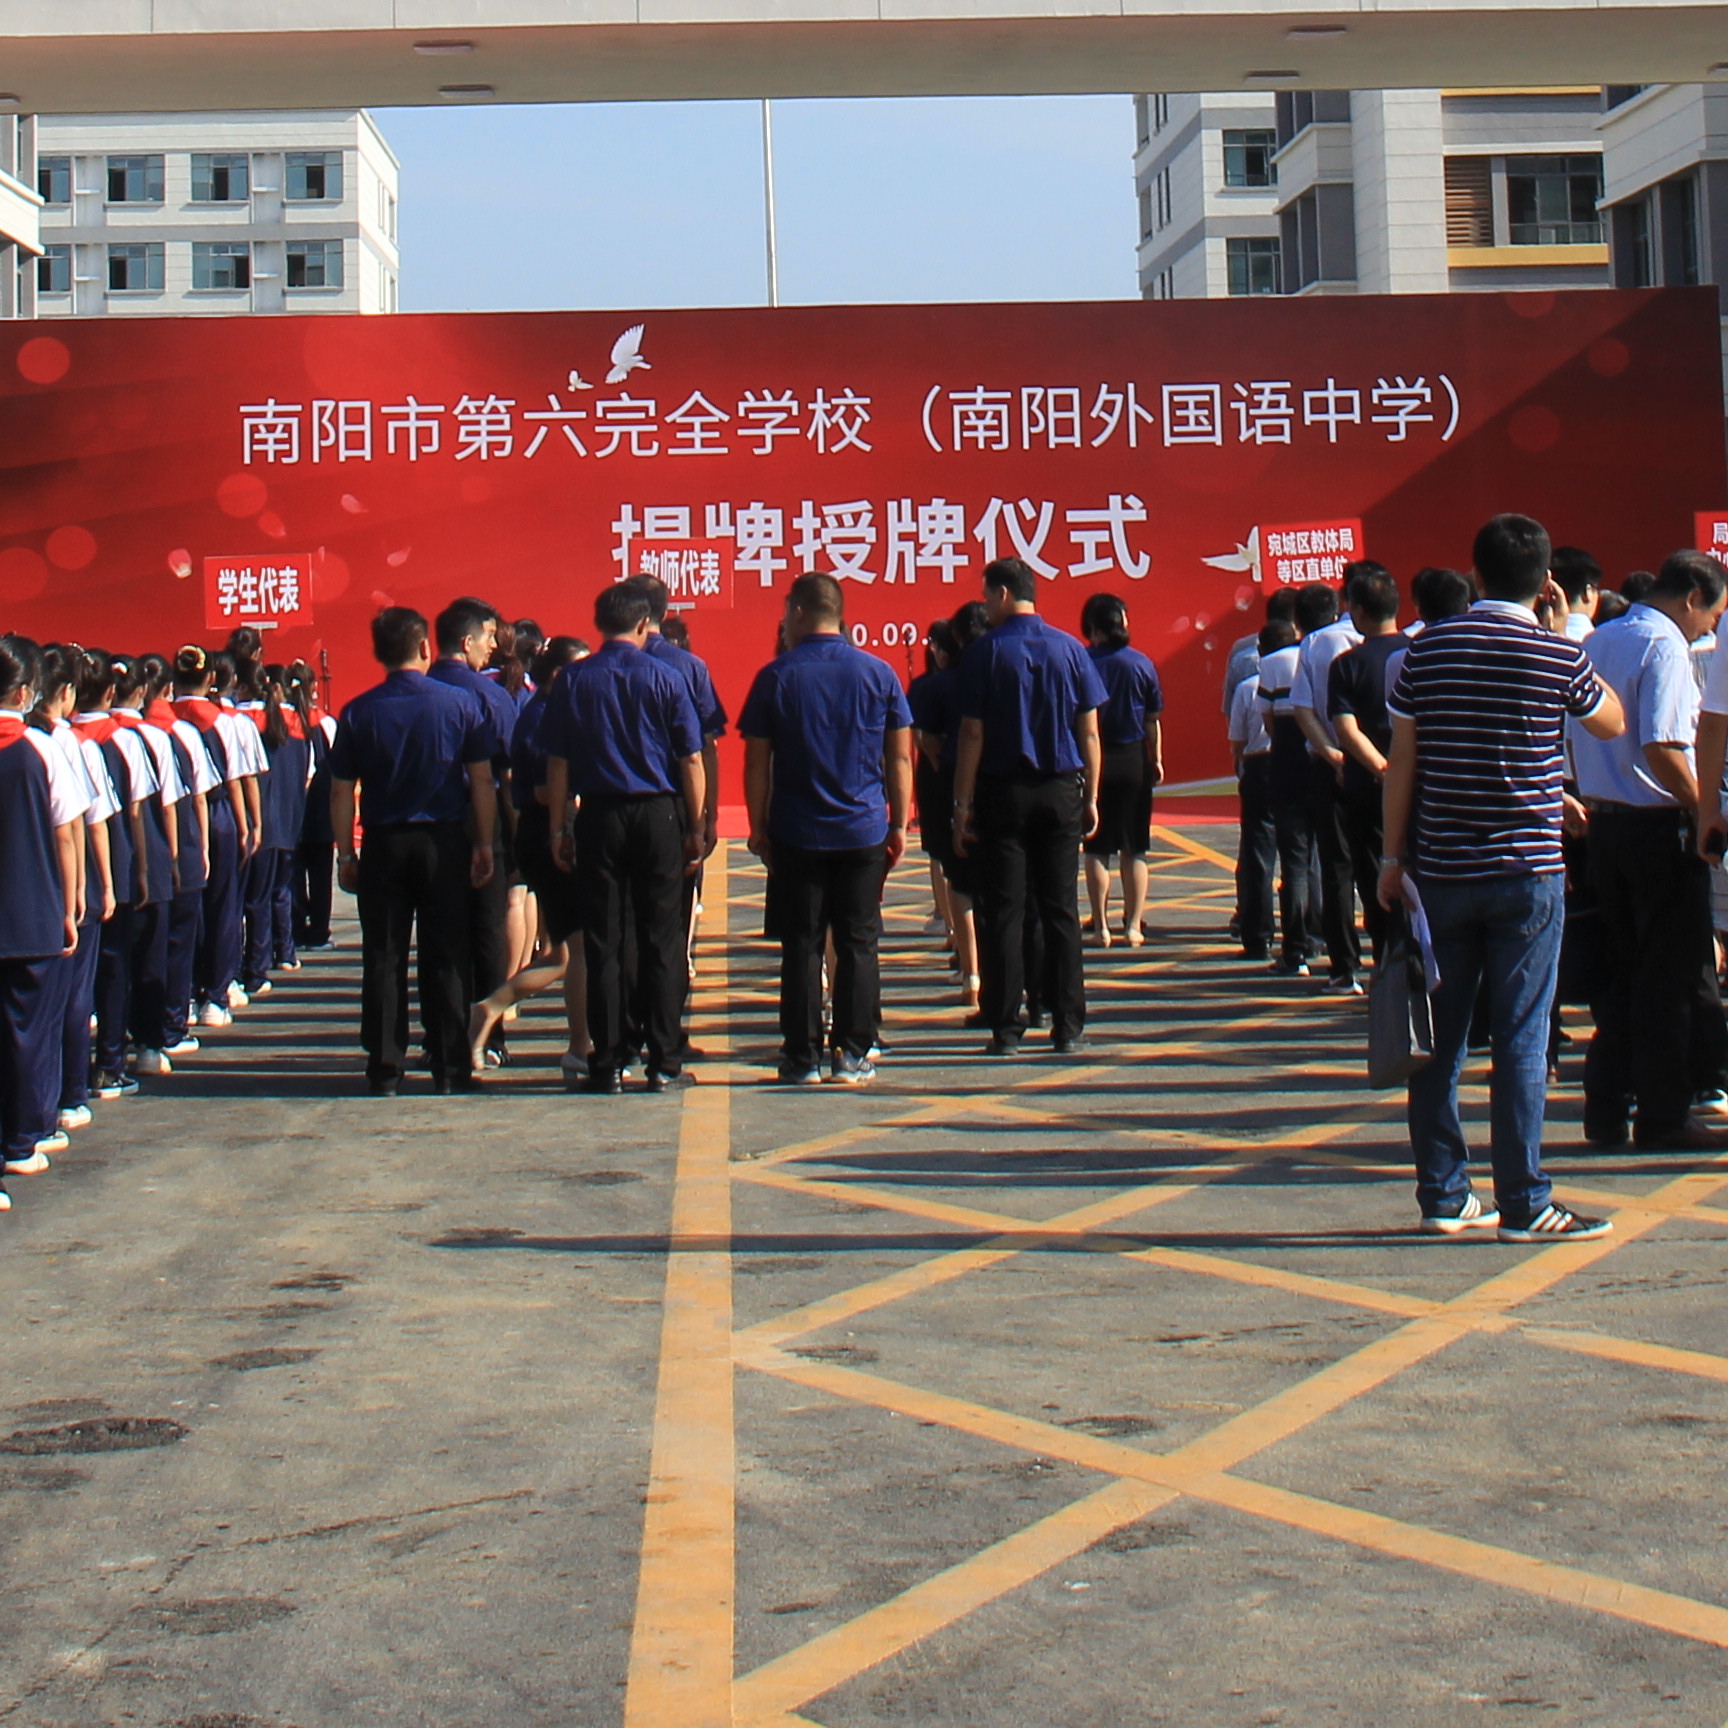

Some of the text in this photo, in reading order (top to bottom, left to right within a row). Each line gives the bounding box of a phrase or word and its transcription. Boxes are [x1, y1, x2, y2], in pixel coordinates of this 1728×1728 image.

[1267, 527, 1354, 557] 宛城区教体局
[218, 565, 300, 616] 学生代表
[639, 548, 721, 597] 教师代表
